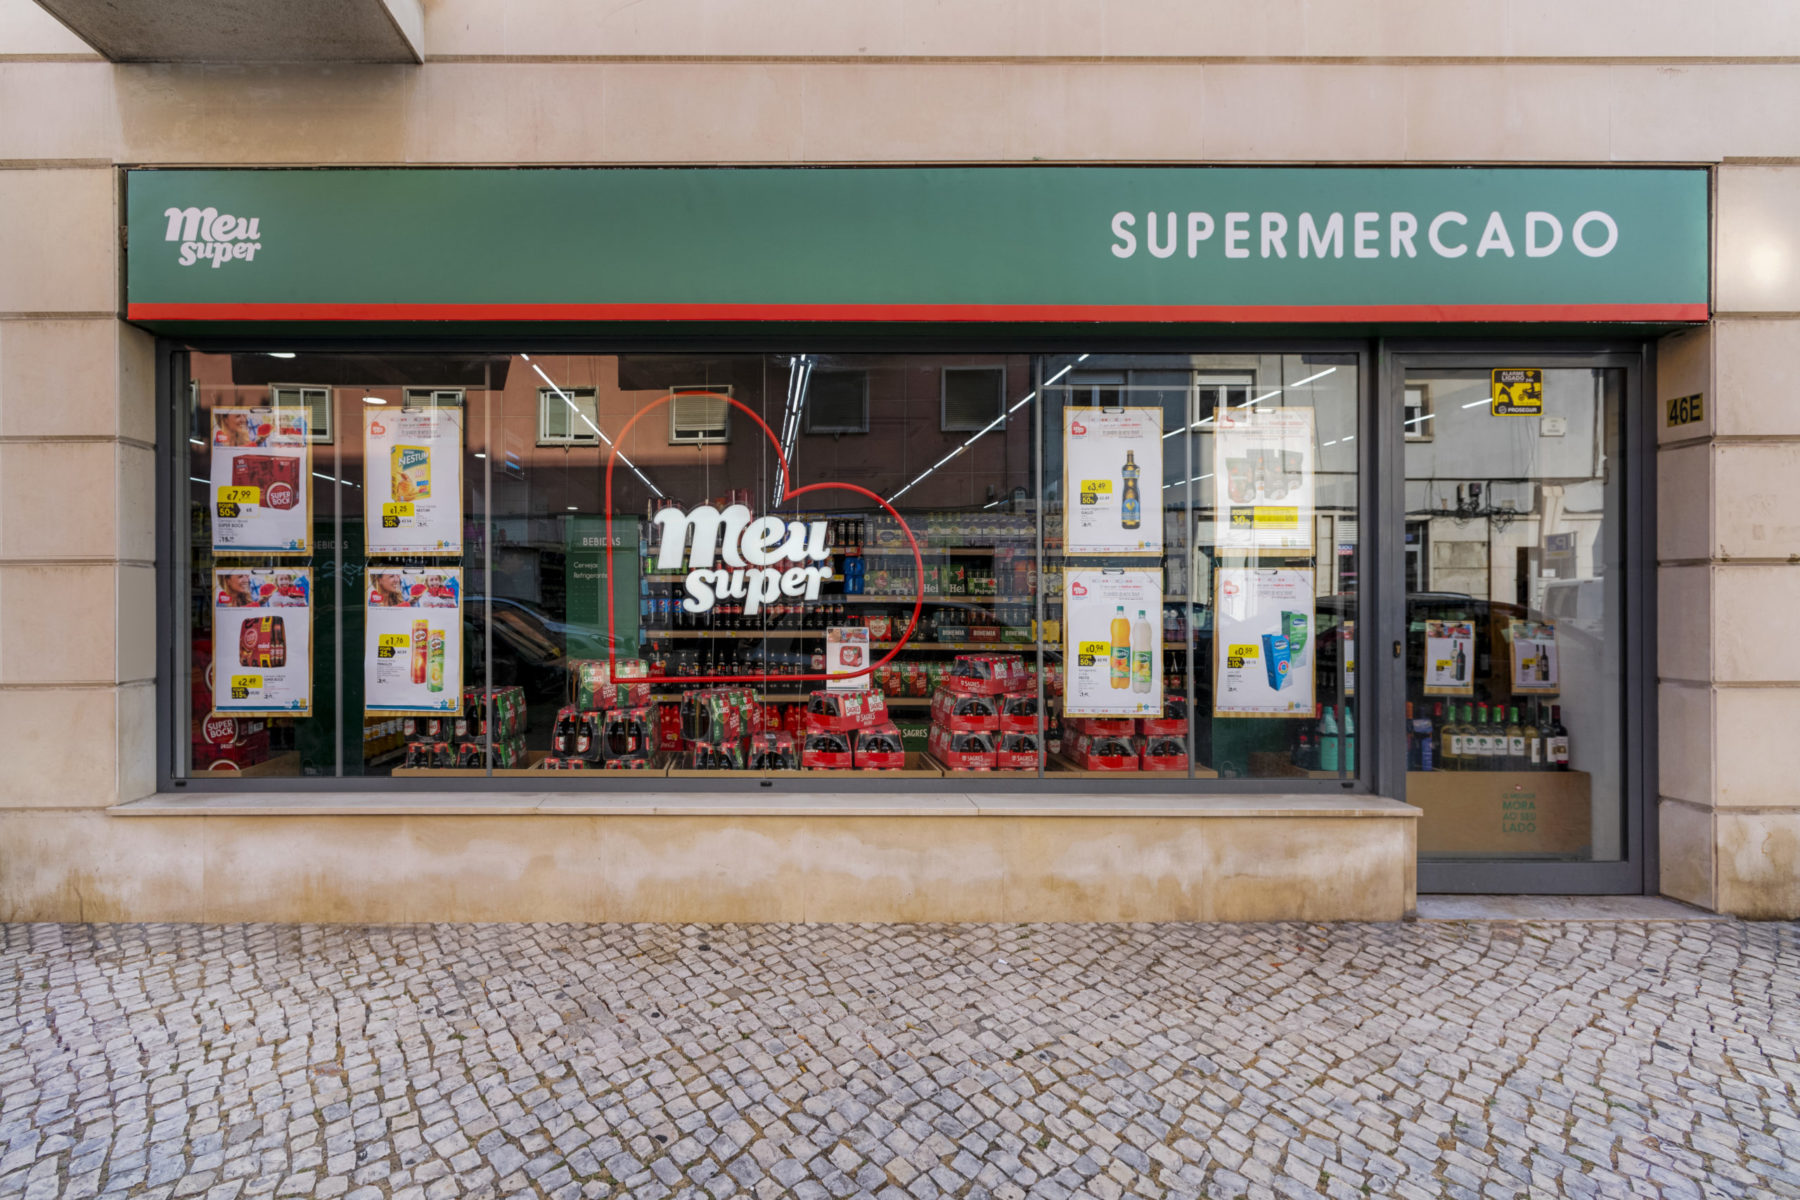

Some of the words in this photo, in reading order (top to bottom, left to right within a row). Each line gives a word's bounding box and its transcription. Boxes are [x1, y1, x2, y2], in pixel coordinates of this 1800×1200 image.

[1111, 210, 1618, 258] SUPERMERCADO
[178, 241, 262, 269] super
[1669, 394, 1701, 425] 46E
[398, 452, 428, 468] NESTUM
[1088, 482, 1106, 491] €3,49
[227, 490, 251, 502] €7,99
[271, 491, 291, 499] SUPER
[272, 496, 290, 505] BOCK
[219, 508, 236, 516] 50%
[682, 566, 832, 616] super
[1086, 644, 1104, 653] €0,94
[207, 719, 233, 731] SUPER
[210, 727, 233, 738] BOCK
[902, 728, 928, 738] SAGRES
[1503, 800, 1536, 810] MORA
[1502, 822, 1536, 832] LADO
